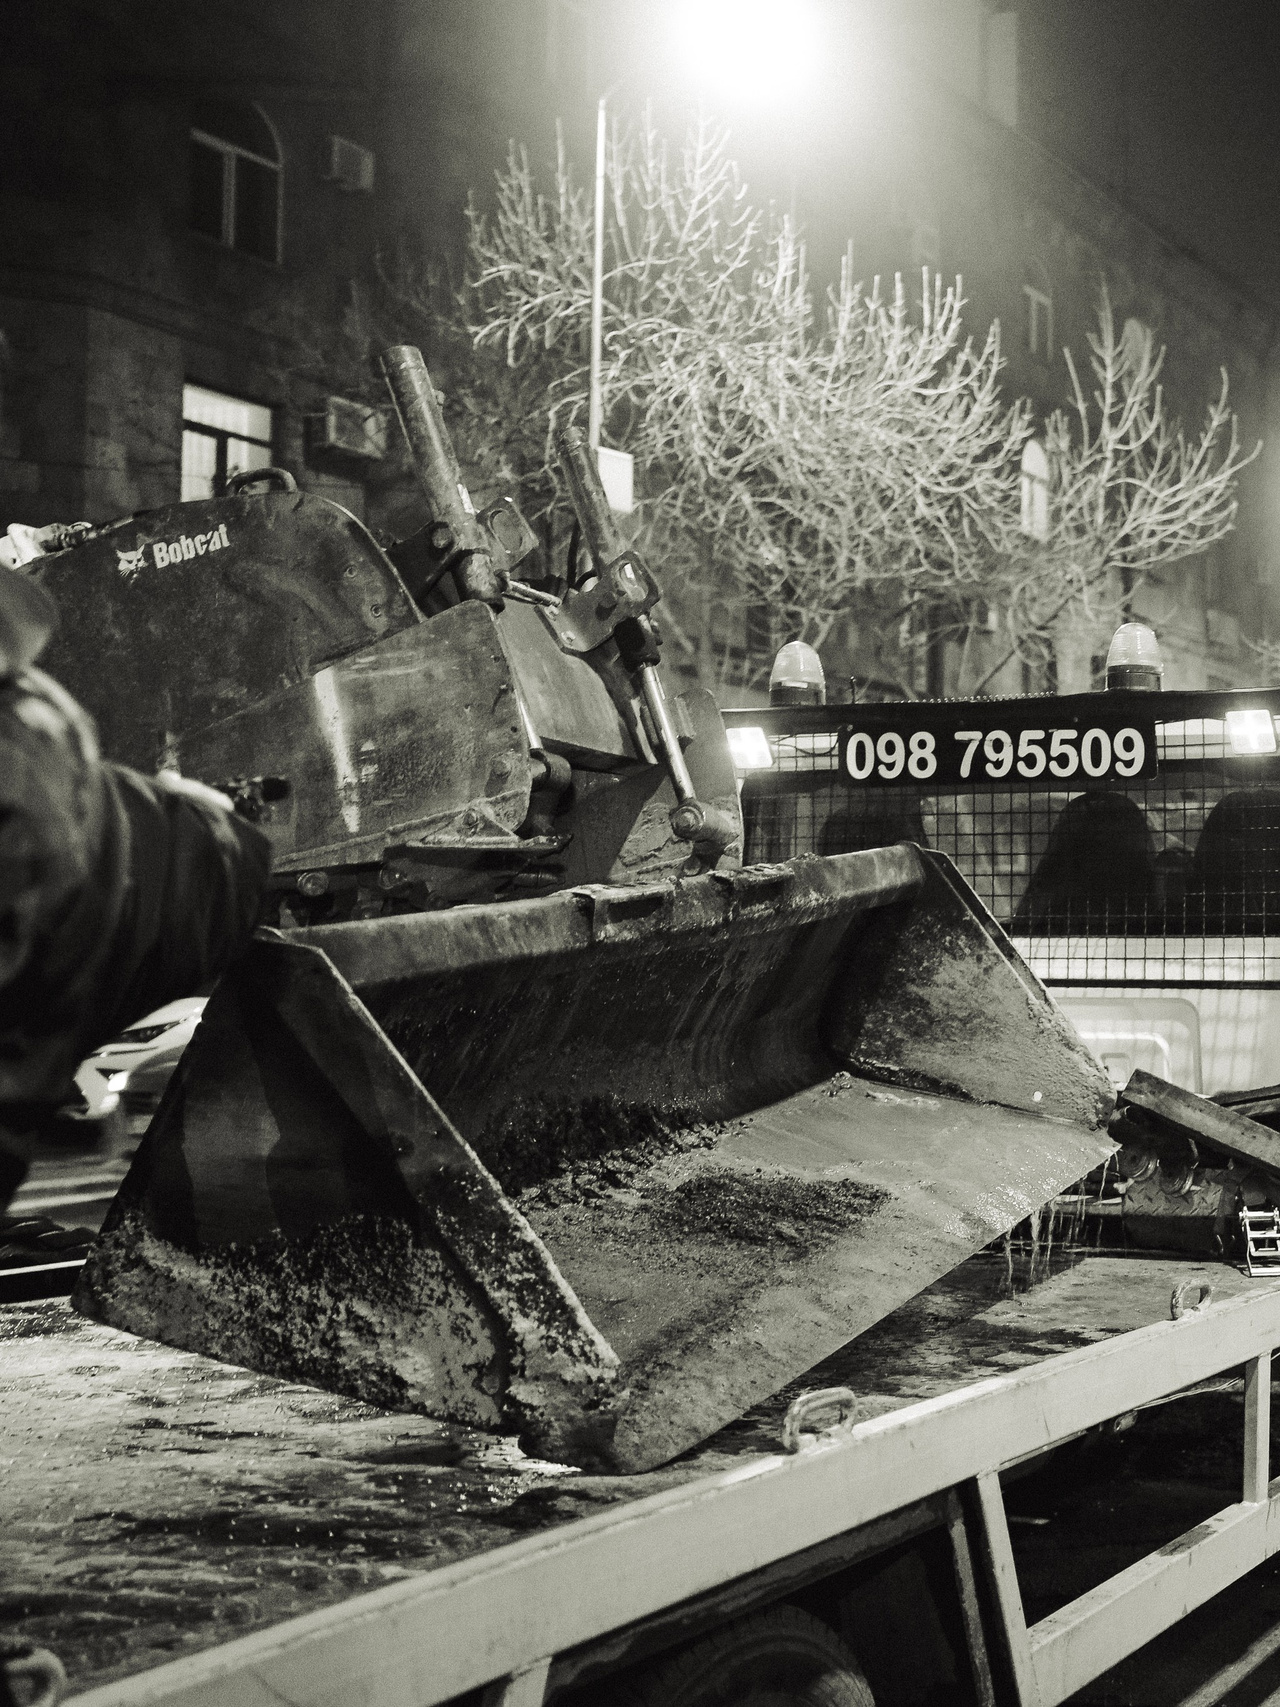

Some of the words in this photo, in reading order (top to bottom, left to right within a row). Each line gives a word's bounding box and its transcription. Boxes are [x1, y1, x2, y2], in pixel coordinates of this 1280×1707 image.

[153, 523, 230, 569] Bobcat
[846, 731, 937, 780] 098
[954, 728, 1145, 778] 795509
